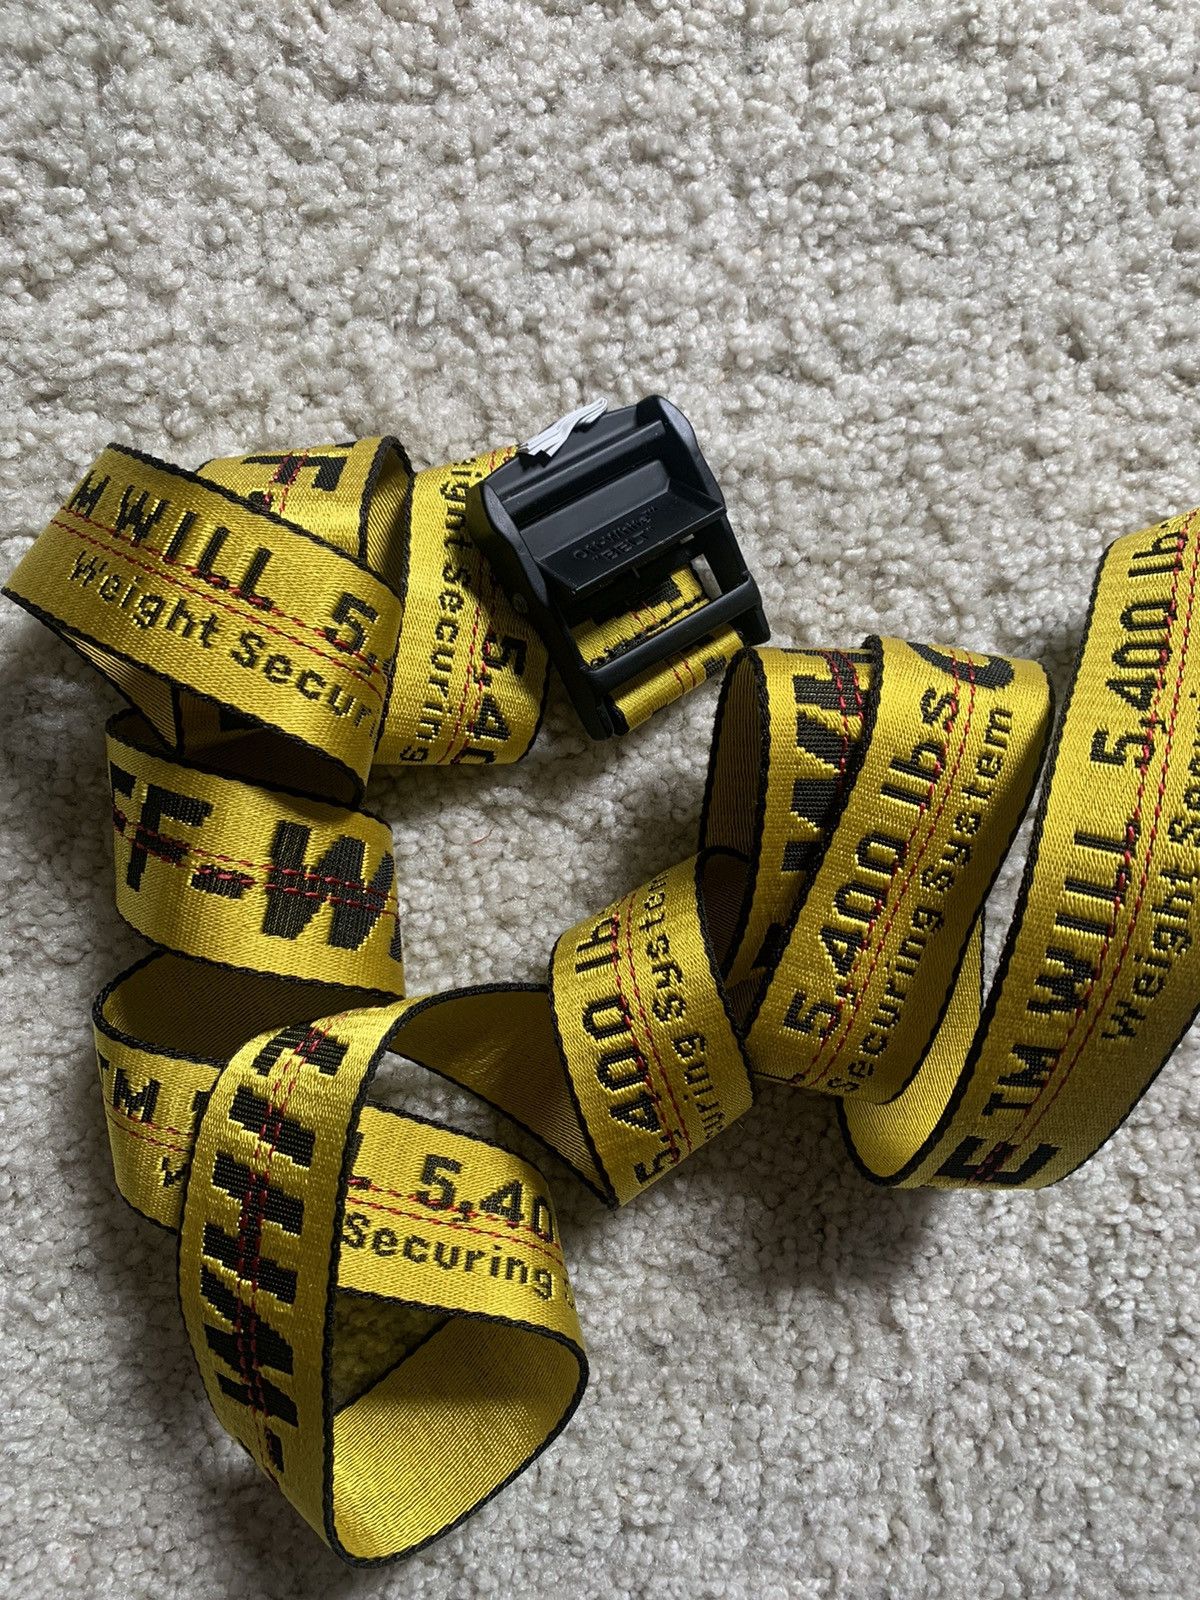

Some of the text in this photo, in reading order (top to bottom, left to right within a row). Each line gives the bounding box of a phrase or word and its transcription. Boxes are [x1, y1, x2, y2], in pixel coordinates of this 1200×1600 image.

[68, 550, 221, 649] Weight
[112, 484, 275, 612] WILL
[1128, 522, 1189, 577] lb
[1090, 600, 1177, 767] 5,400
[783, 831, 908, 1042] 5,400
[880, 687, 959, 811] lbs
[827, 906, 944, 1091] Securing
[922, 706, 1014, 893] System
[1027, 818, 1140, 1014] WILL
[575, 910, 622, 974] lb
[1101, 866, 1200, 1040] Weight
[340, 1211, 554, 1301] Securing
